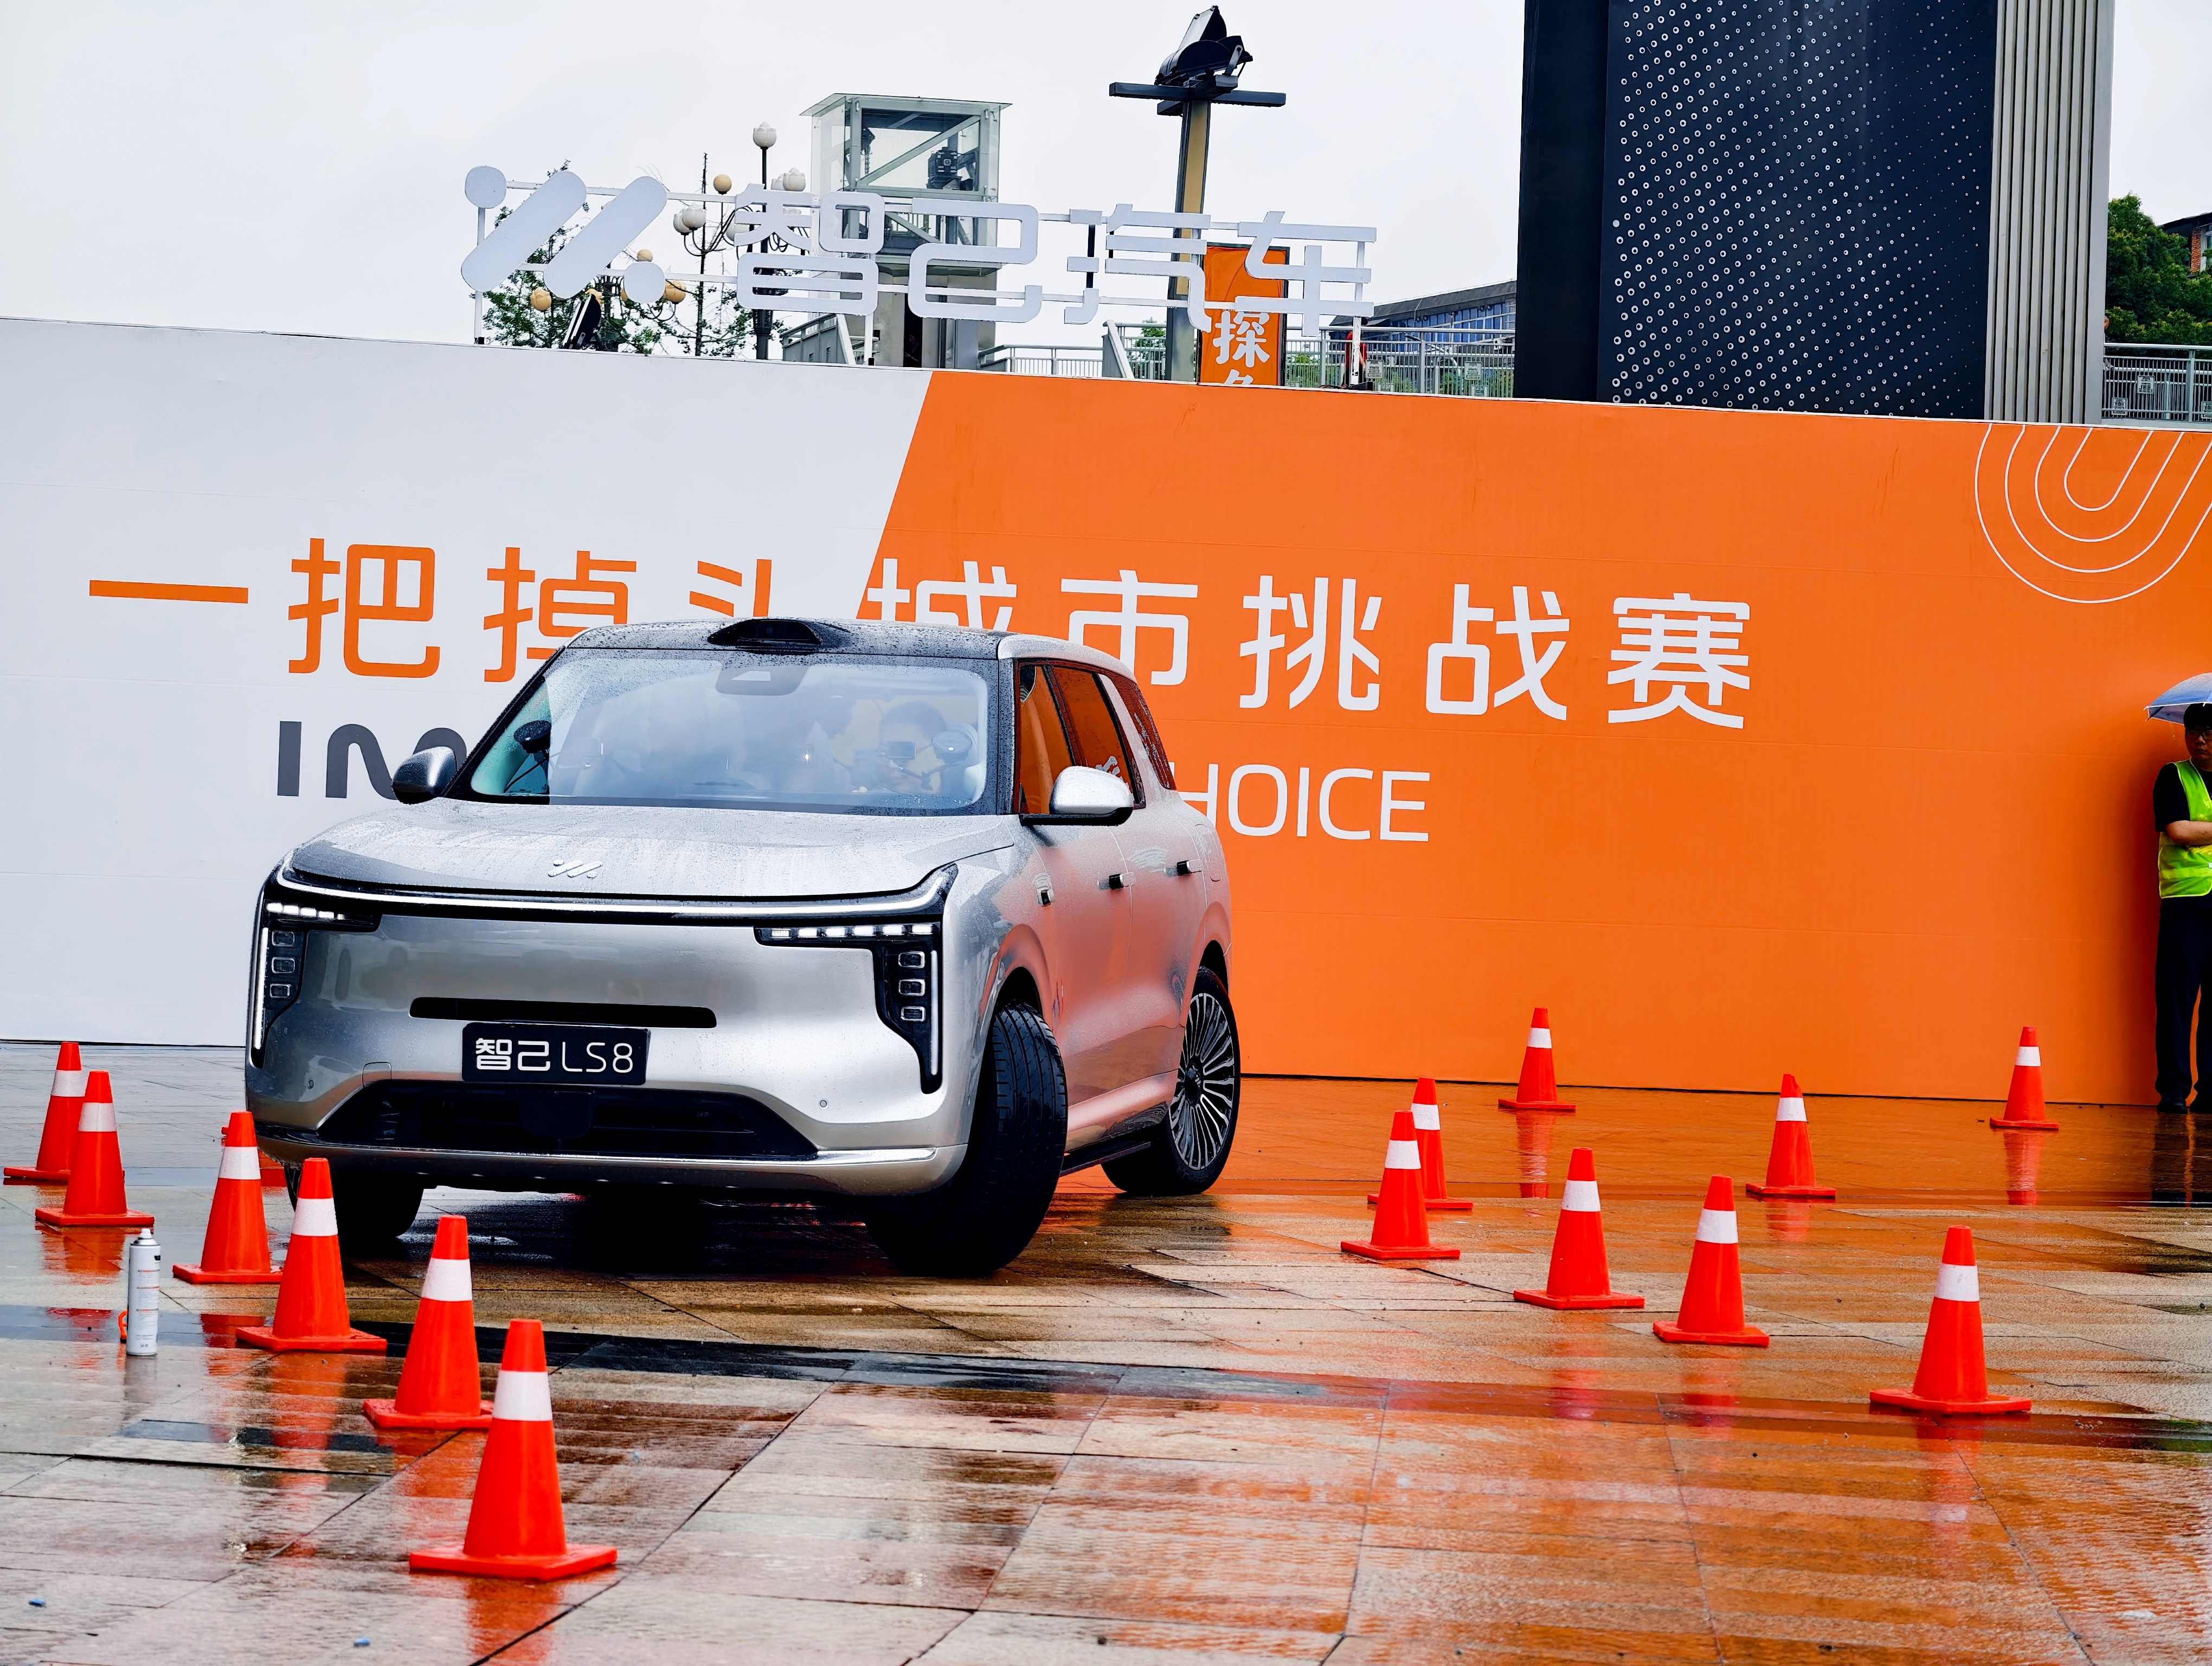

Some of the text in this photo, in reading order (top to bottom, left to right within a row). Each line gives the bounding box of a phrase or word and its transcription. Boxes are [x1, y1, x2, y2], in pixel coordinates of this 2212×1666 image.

[734, 183, 1377, 337] 智己汽车
[475, 1037, 551, 1071] 智己
[562, 1041, 633, 1073] LS8
